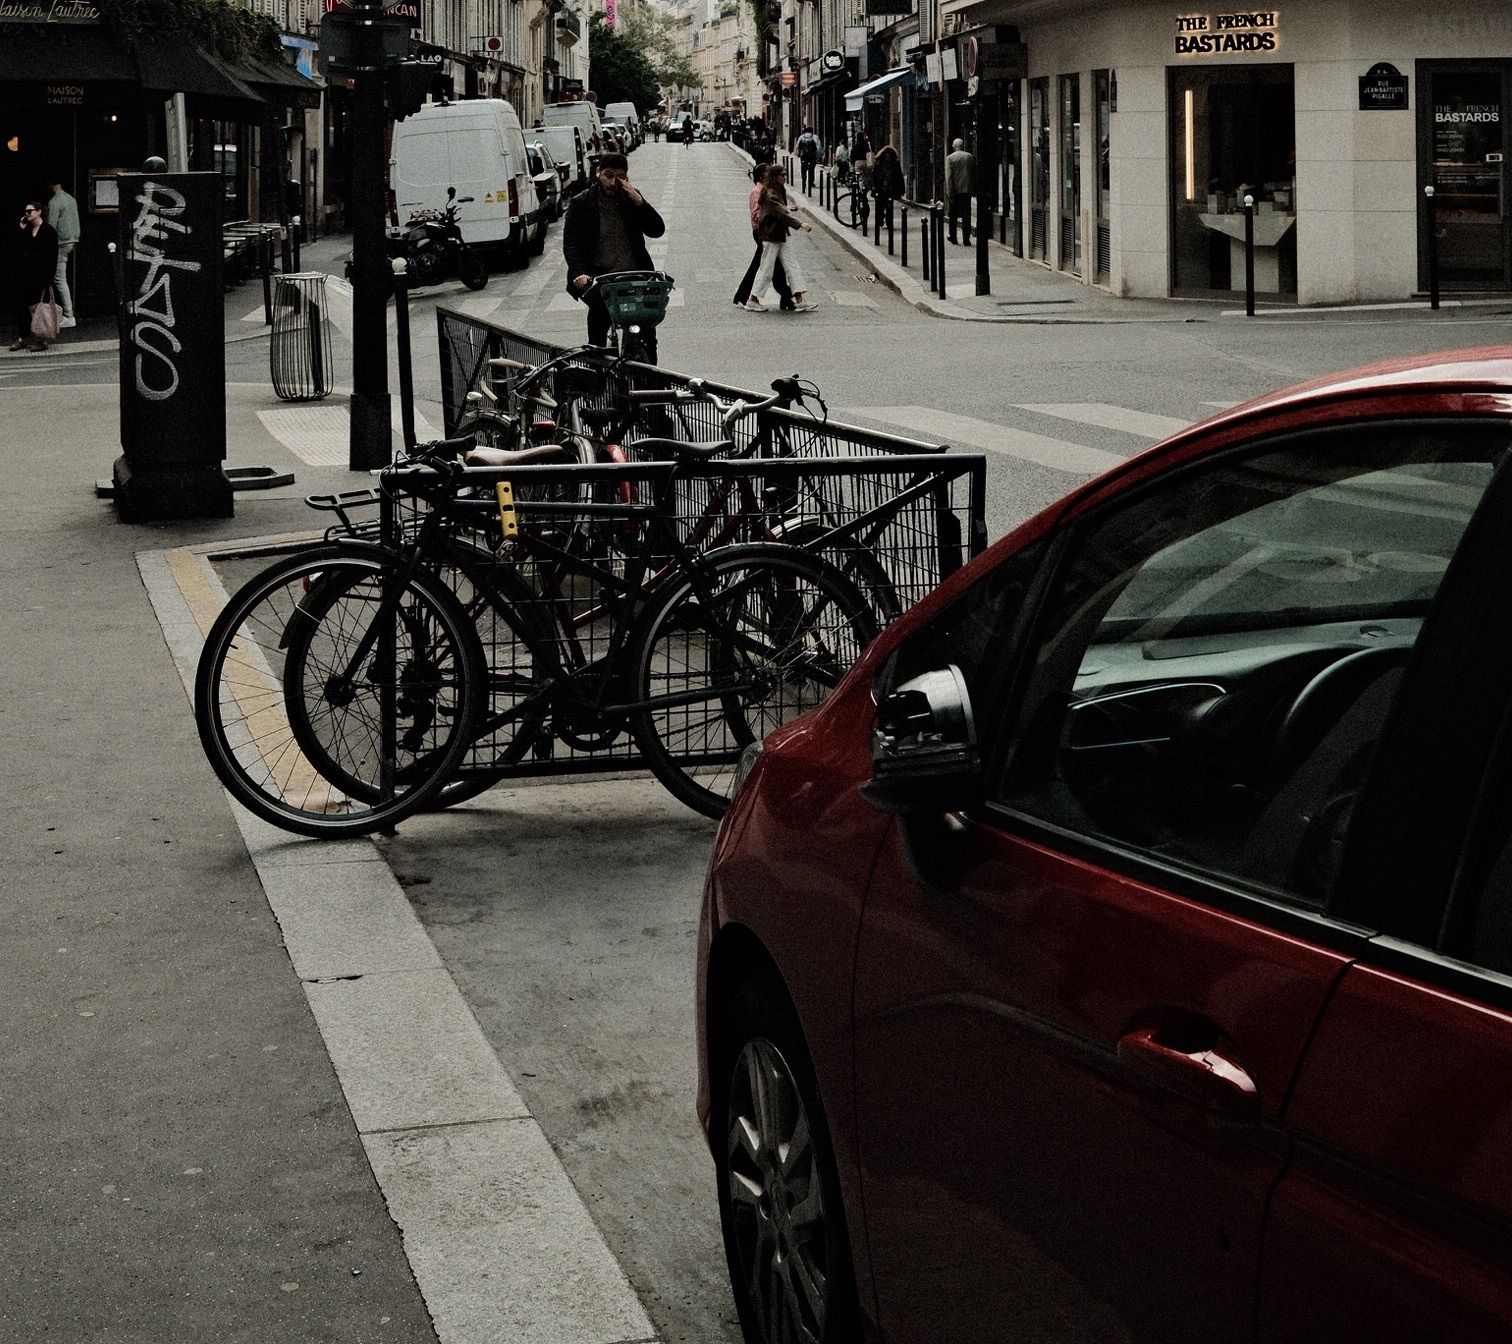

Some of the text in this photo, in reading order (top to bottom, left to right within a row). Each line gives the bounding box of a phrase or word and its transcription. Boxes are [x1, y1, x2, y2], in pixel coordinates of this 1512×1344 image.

[383, 4, 417, 17] NCAN
[1175, 13, 1275, 31] THE FRENCH
[1175, 32, 1276, 53] BASTARDS
[47, 86, 85, 95] MAISON
[1435, 104, 1499, 113] THE FRENCH
[1435, 112, 1499, 122] BASTARDS
